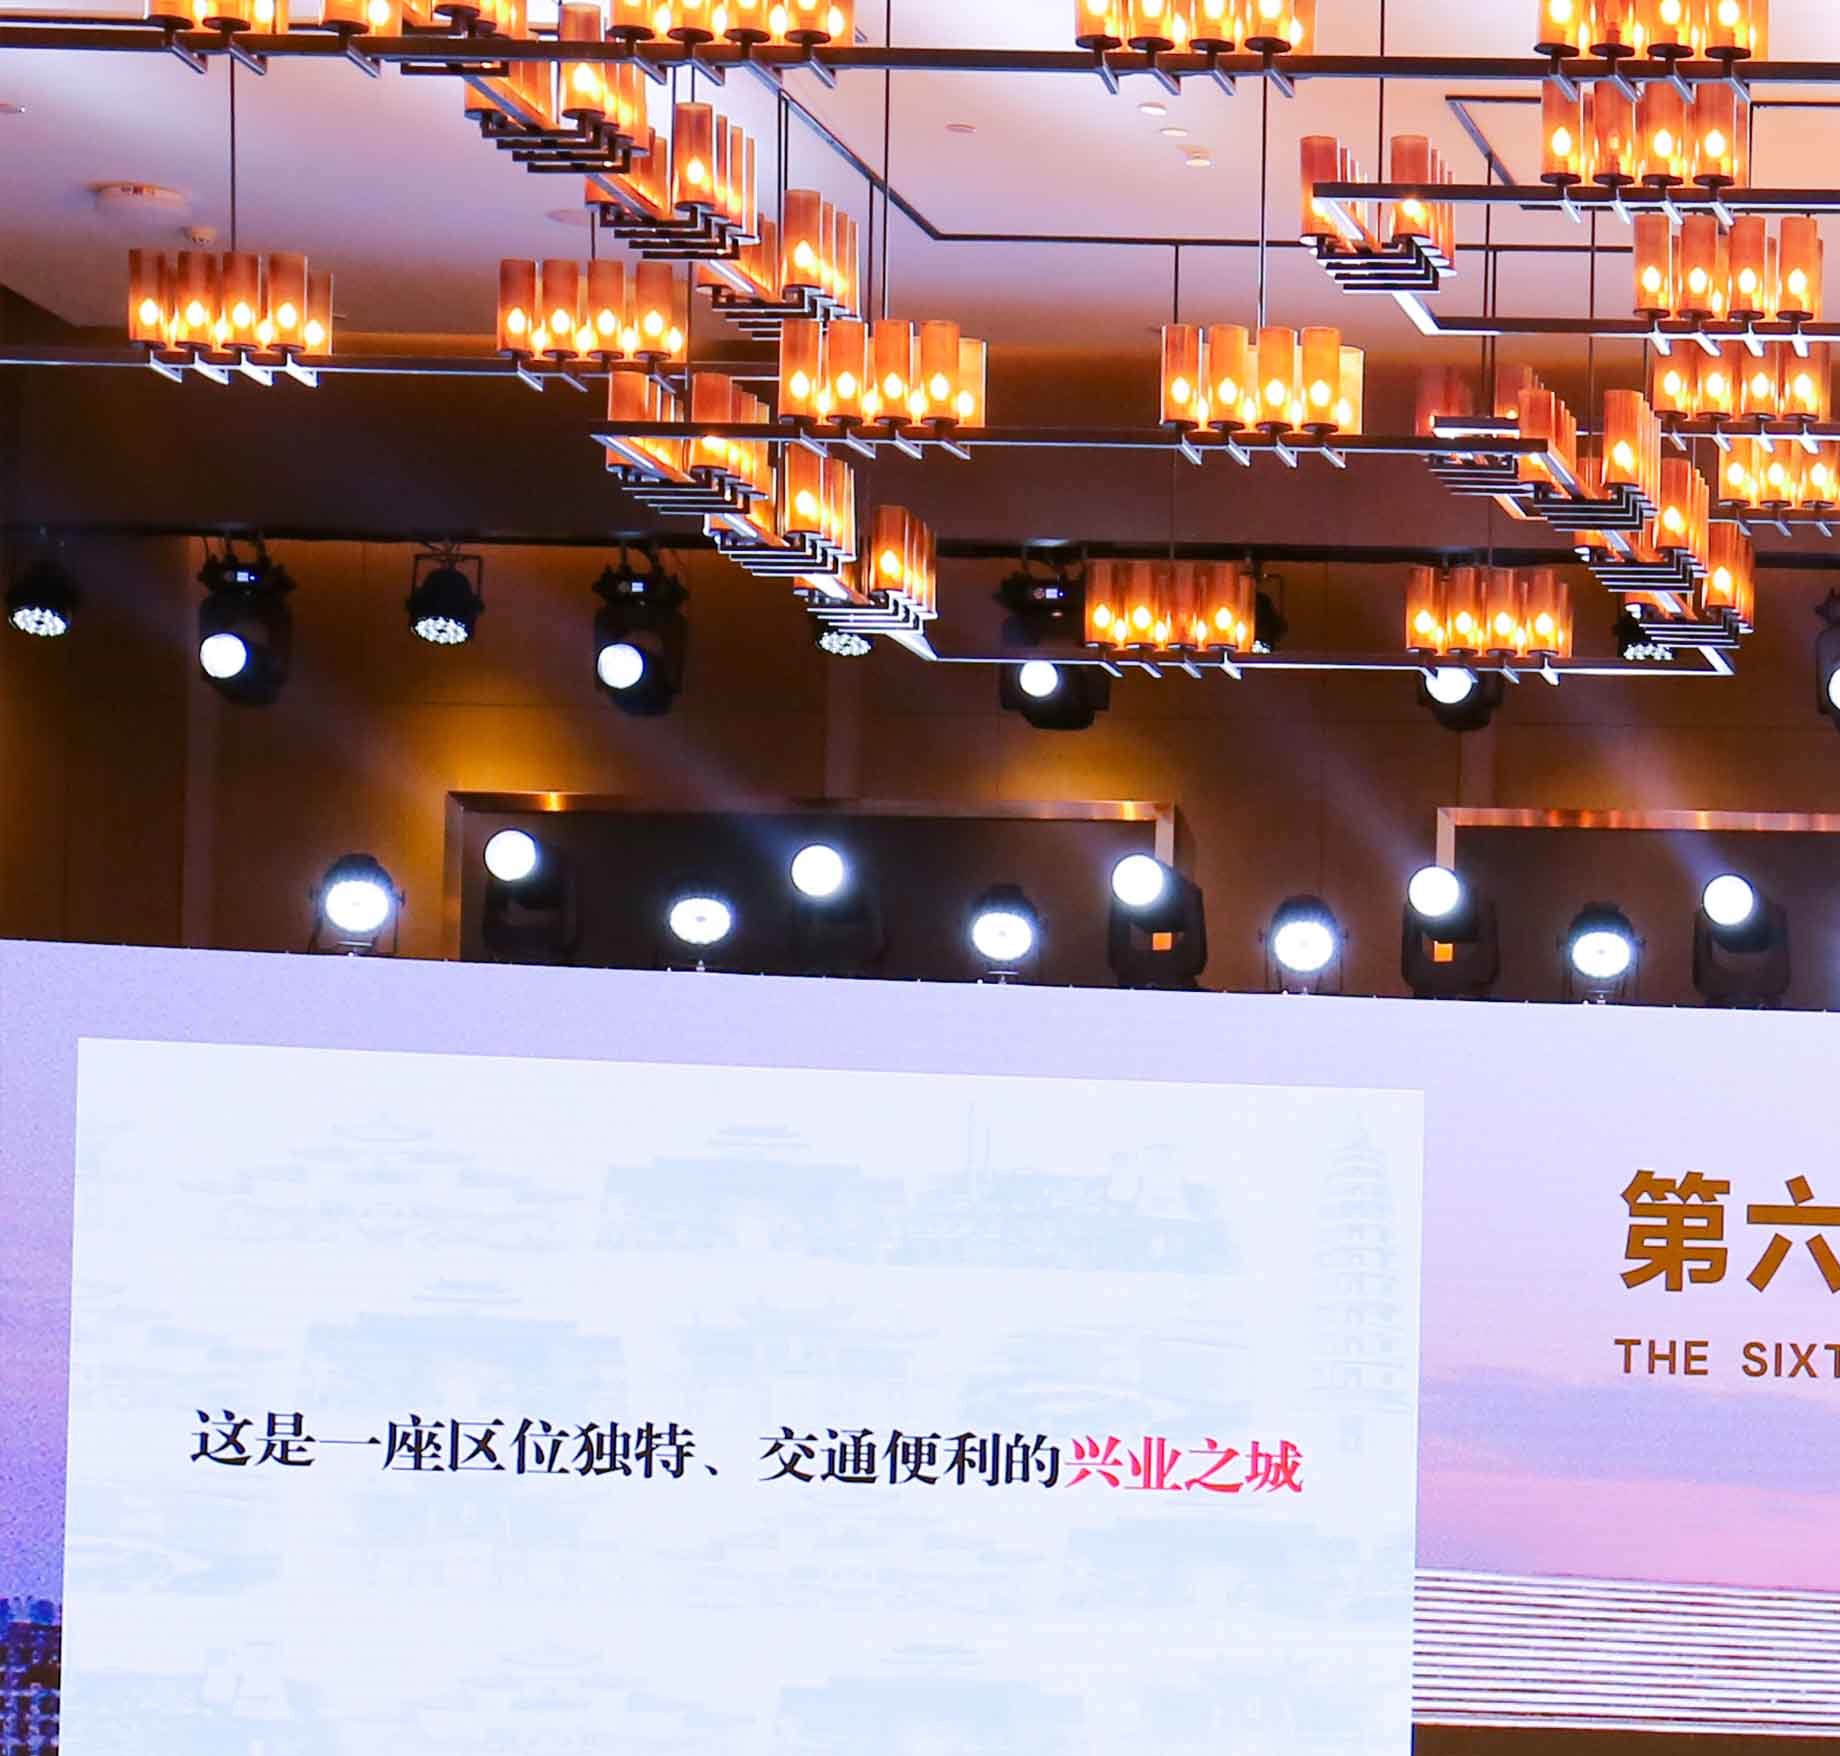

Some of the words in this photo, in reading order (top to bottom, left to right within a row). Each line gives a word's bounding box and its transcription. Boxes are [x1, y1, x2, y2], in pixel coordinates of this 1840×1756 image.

[1614, 1337, 1711, 1378] THE
[190, 1408, 1304, 1496] 这是一座区位独特、交通便利的兴业之城
